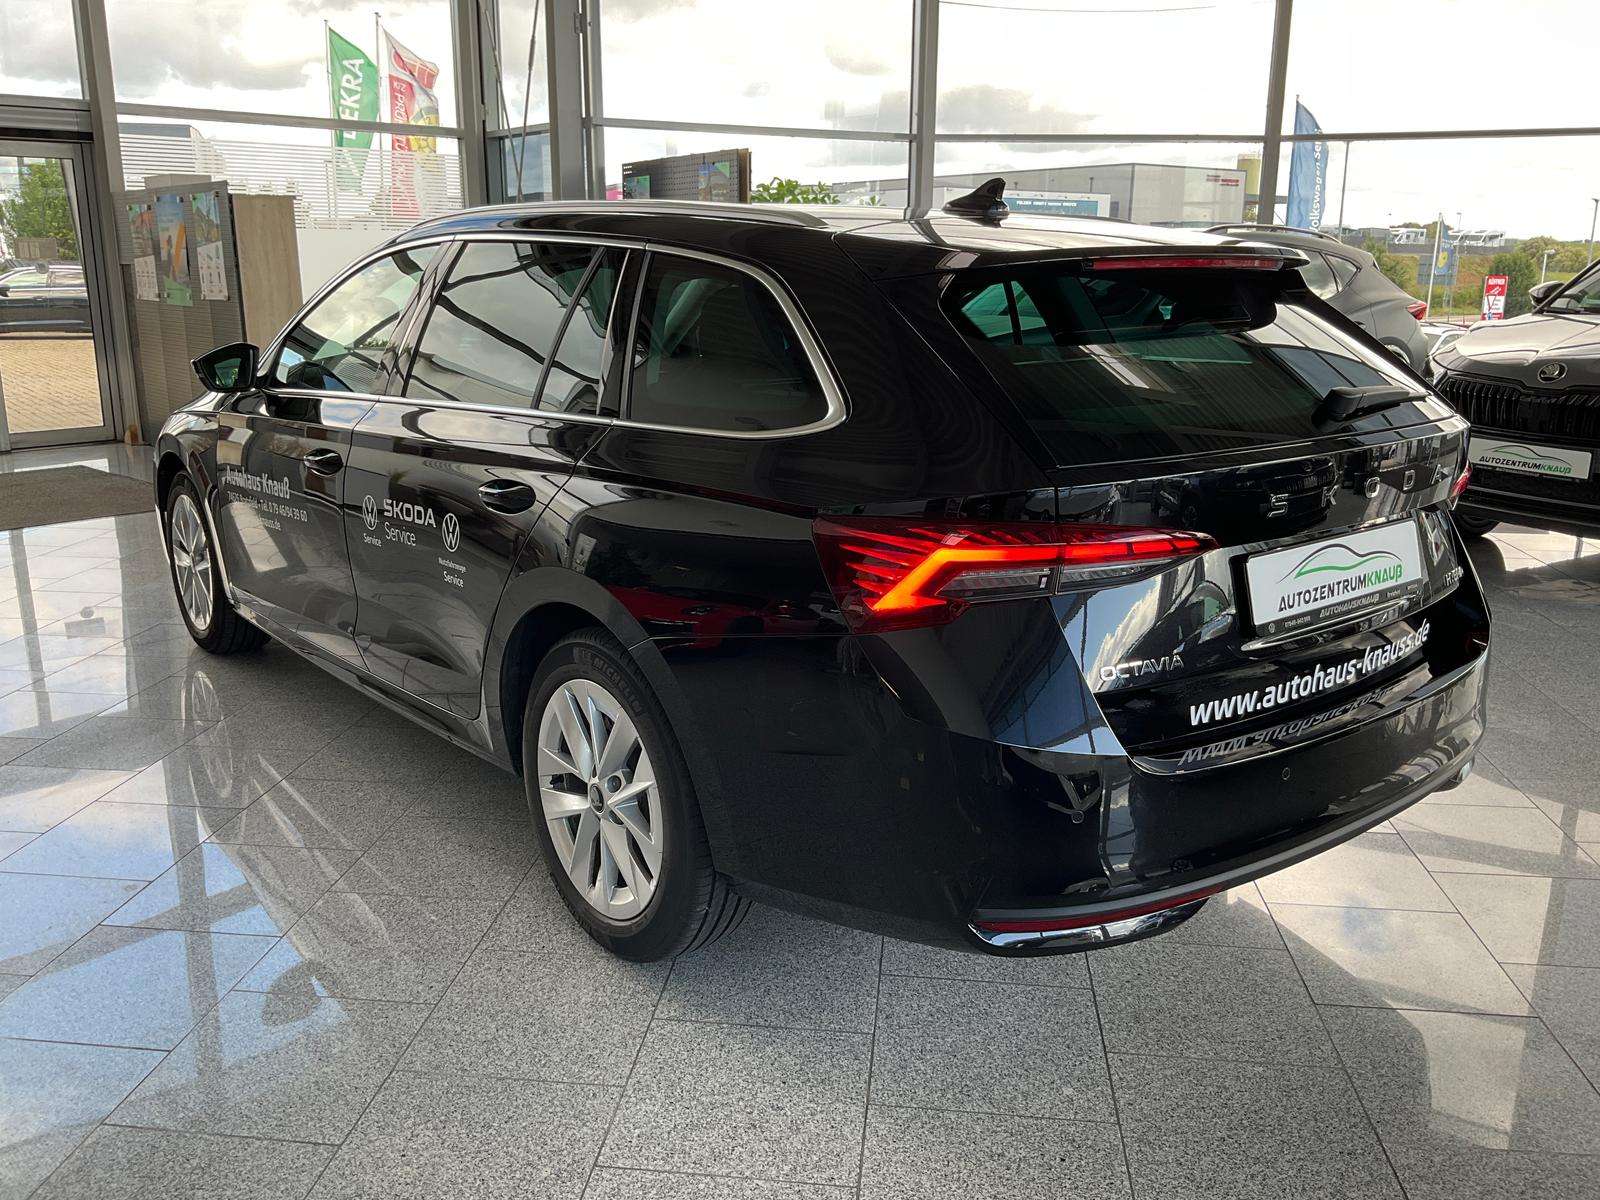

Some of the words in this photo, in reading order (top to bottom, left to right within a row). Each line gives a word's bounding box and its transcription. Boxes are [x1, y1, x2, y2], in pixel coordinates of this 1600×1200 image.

[363, 532, 382, 547] Service
[385, 521, 417, 547] Service
[443, 571, 464, 588] Service
[1100, 654, 1185, 682] OCTAVIA
[1189, 617, 1431, 727] www.autohaus-knauss.de
